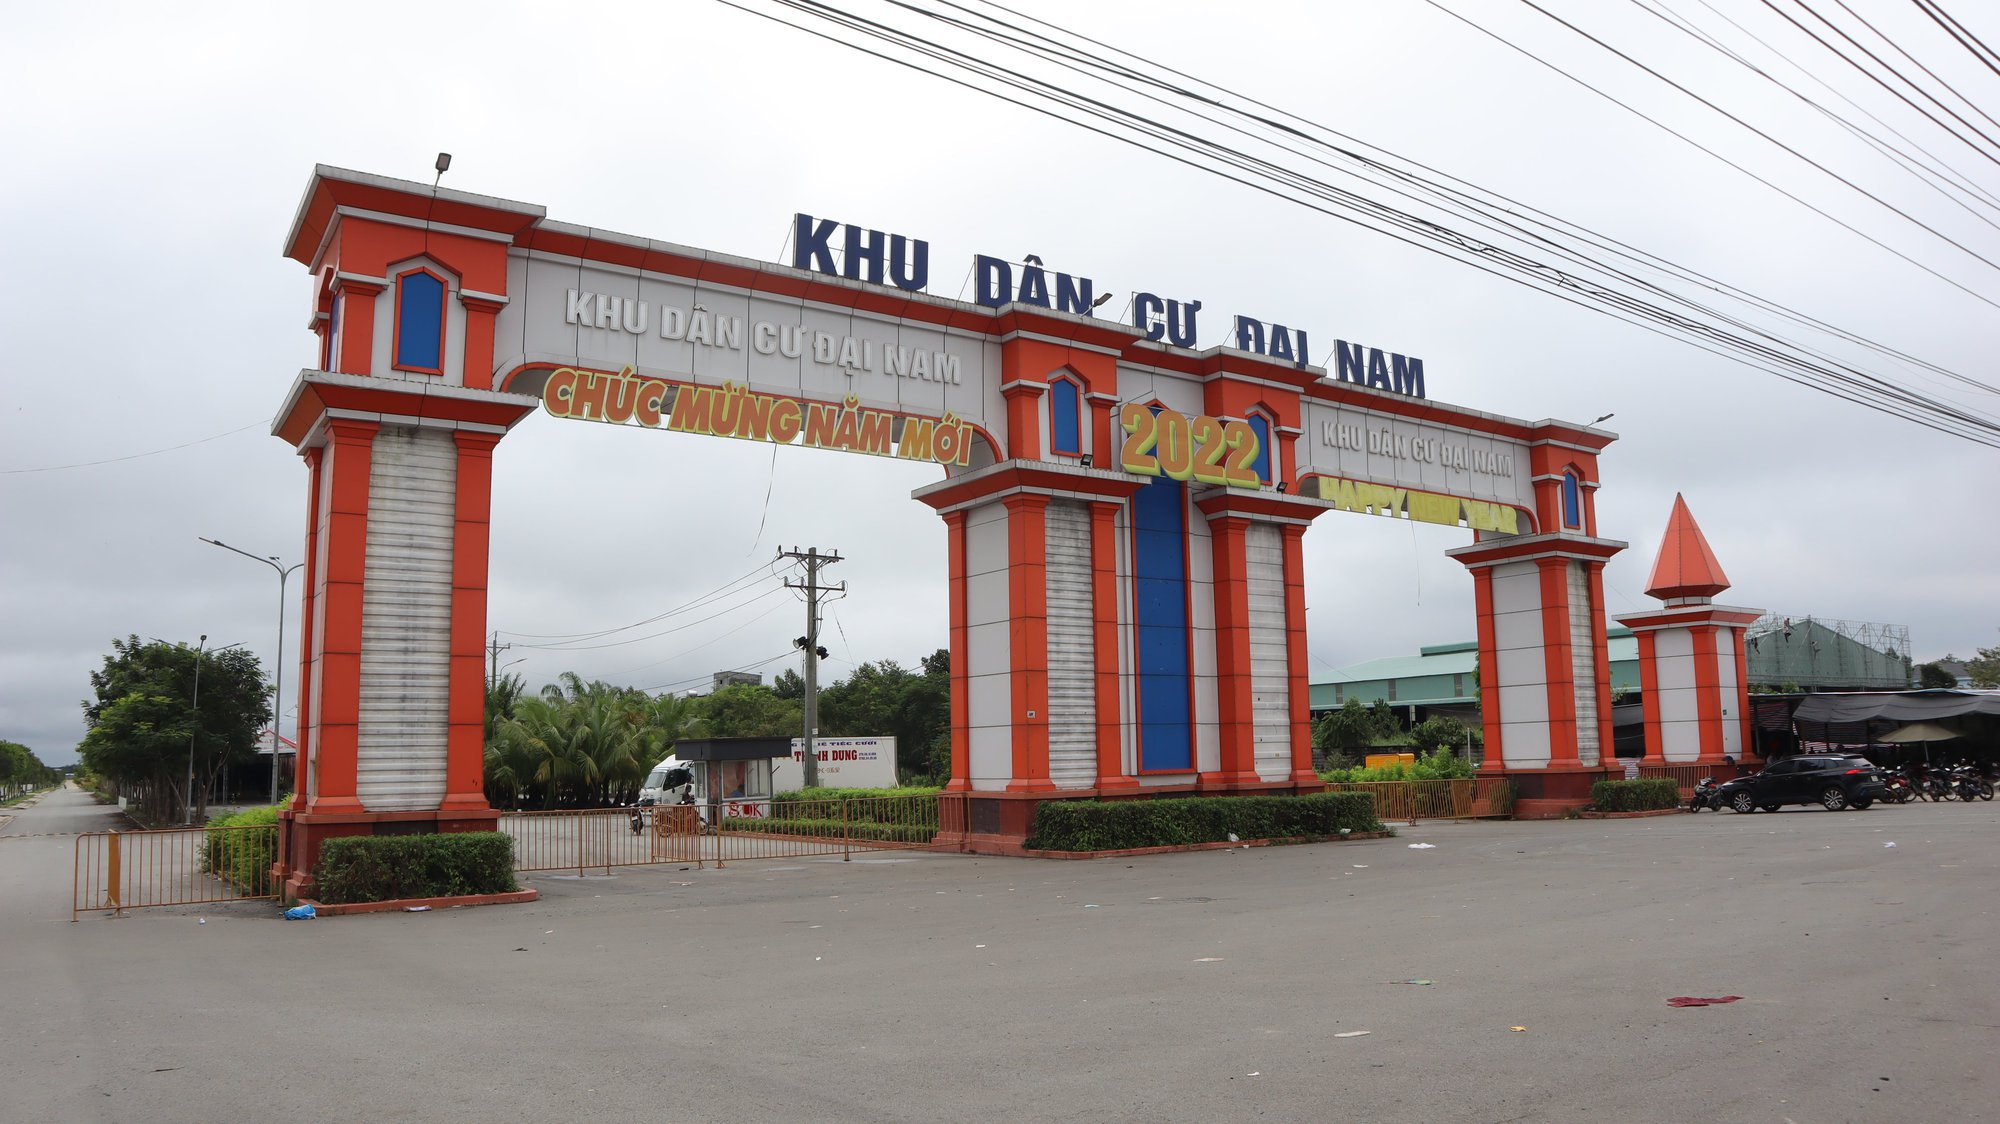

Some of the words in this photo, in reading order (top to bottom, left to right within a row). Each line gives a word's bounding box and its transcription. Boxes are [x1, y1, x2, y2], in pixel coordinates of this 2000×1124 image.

[566, 288, 649, 334] KHU
[660, 303, 743, 350] DÂN
[753, 321, 808, 358] CƯ
[812, 330, 873, 376] ĐẠI
[884, 343, 962, 385] NAM
[794, 212, 929, 292] KHU
[974, 254, 1093, 317] DÂN
[1134, 292, 1202, 348] CƯ
[1334, 339, 1426, 399] NAM
[543, 363, 669, 428] CHÚC
[668, 379, 802, 445] MỪNG
[803, 391, 893, 456] NĂM
[897, 411, 974, 467] MỚI
[1120, 403, 1261, 490] 2022
[1322, 420, 1362, 452] KHU
[1367, 427, 1407, 460] DÂN
[1411, 436, 1435, 464] CƯ
[1440, 442, 1469, 474] ĐẠI
[1473, 448, 1513, 478] NAM
[794, 750, 828, 762] TNH
[832, 749, 858, 761] DUNG
